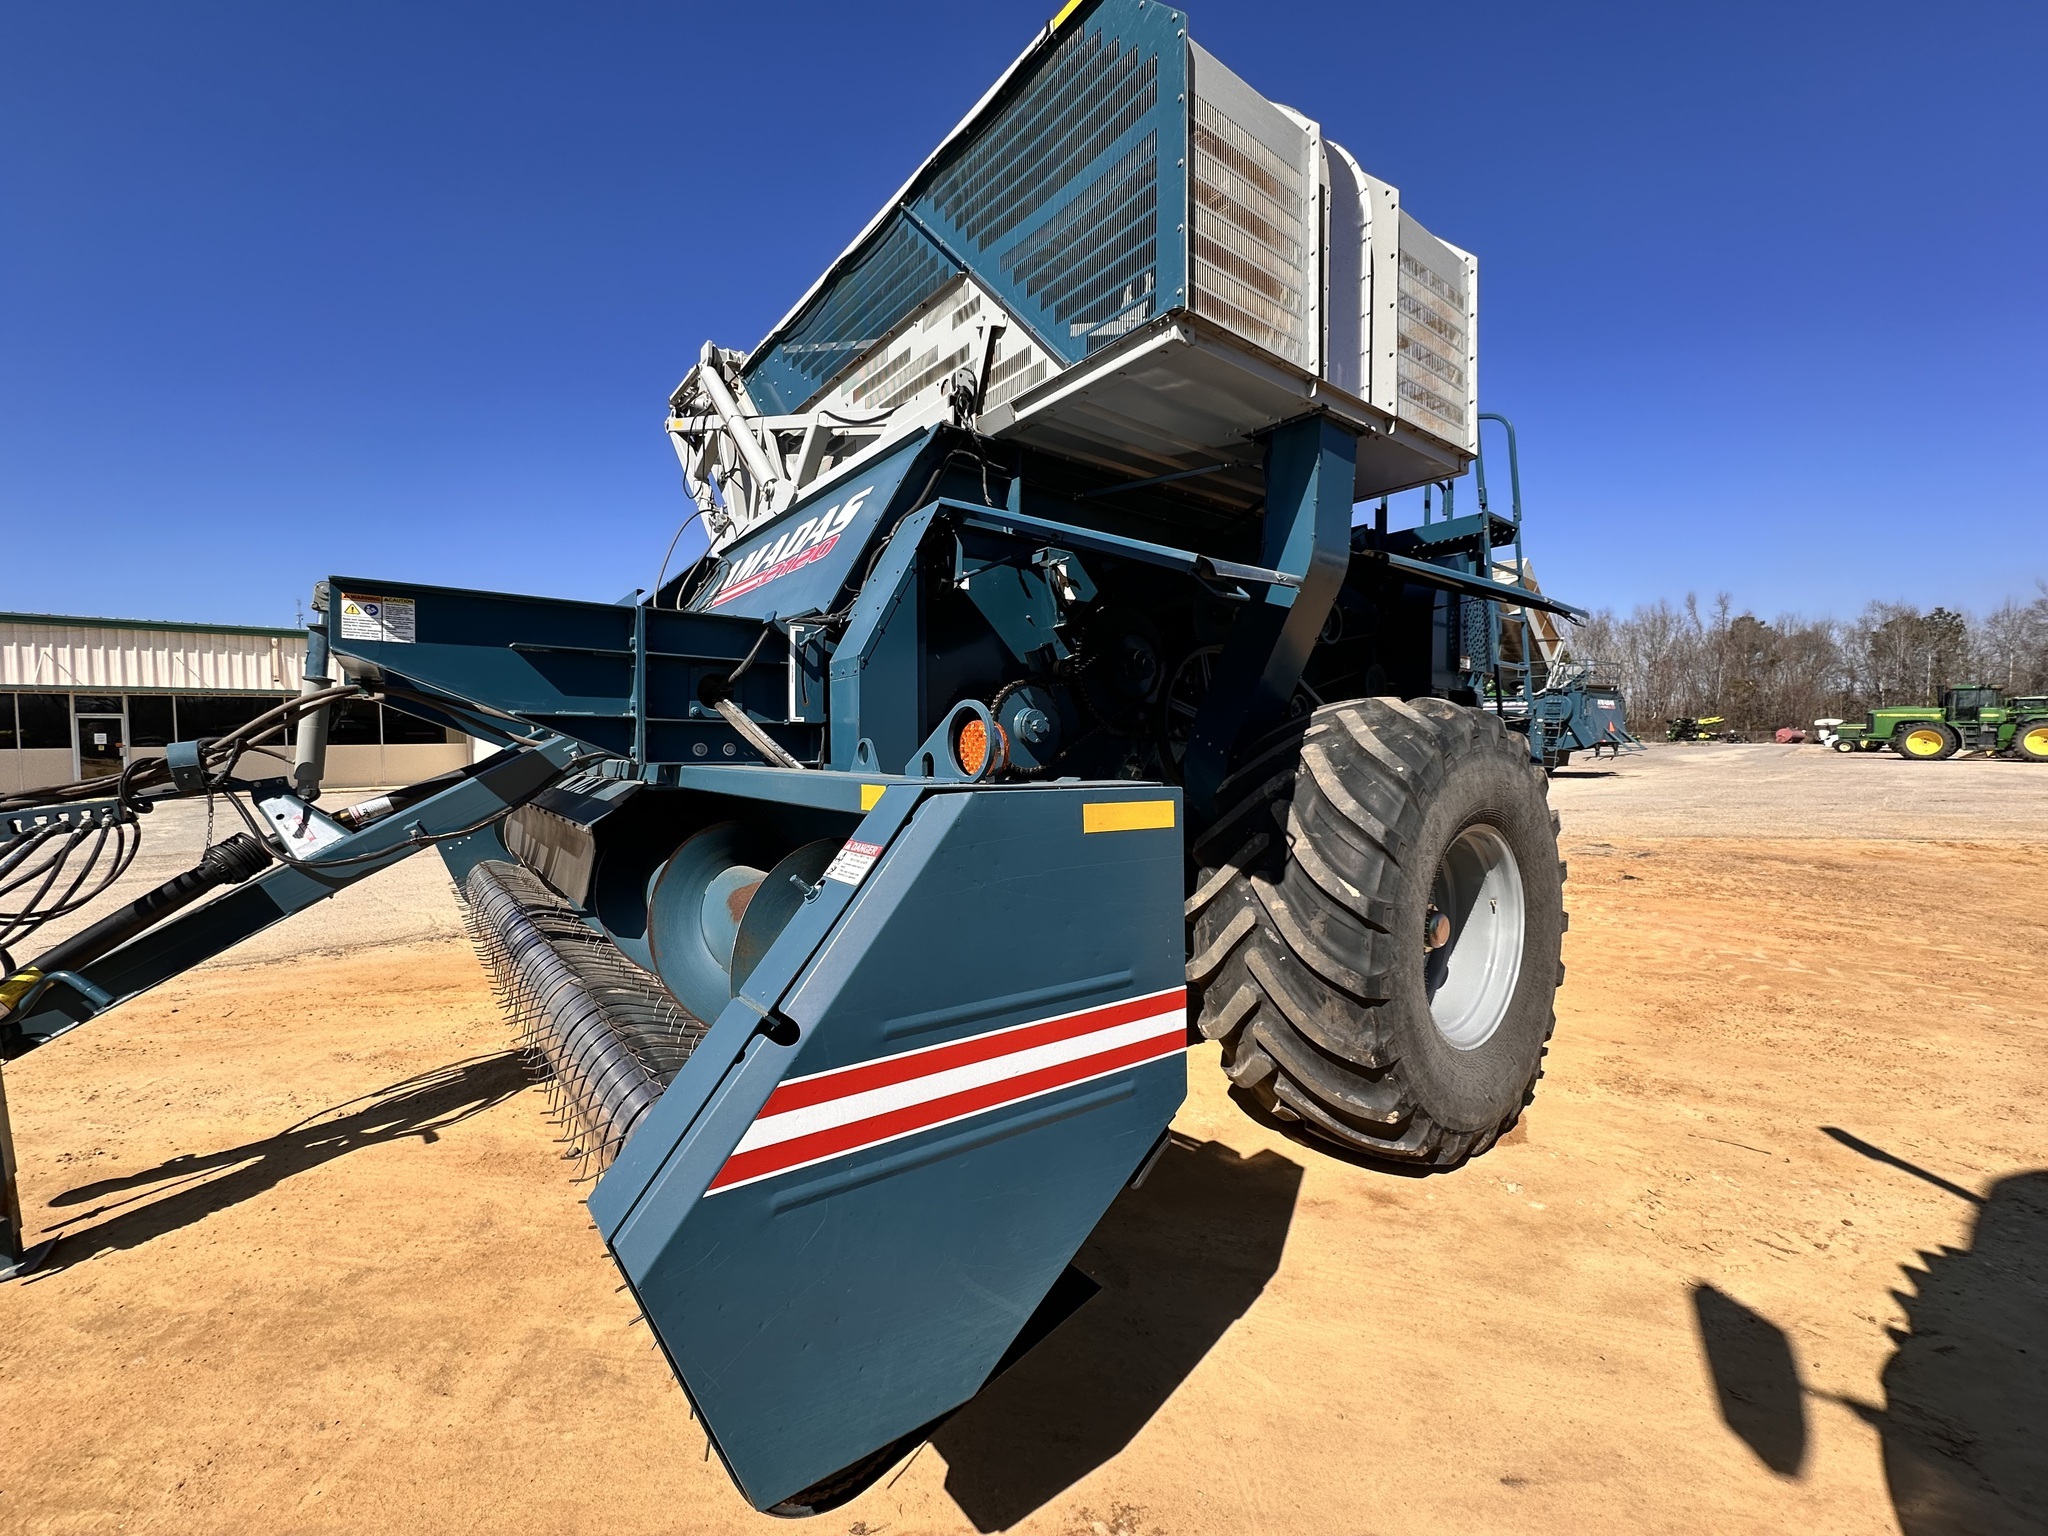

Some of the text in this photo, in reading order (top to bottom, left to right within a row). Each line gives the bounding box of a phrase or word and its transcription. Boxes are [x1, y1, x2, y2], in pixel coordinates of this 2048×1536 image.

[708, 485, 875, 597] AMADAS
[757, 533, 841, 588] 2120
[849, 841, 878, 856] DANGER
